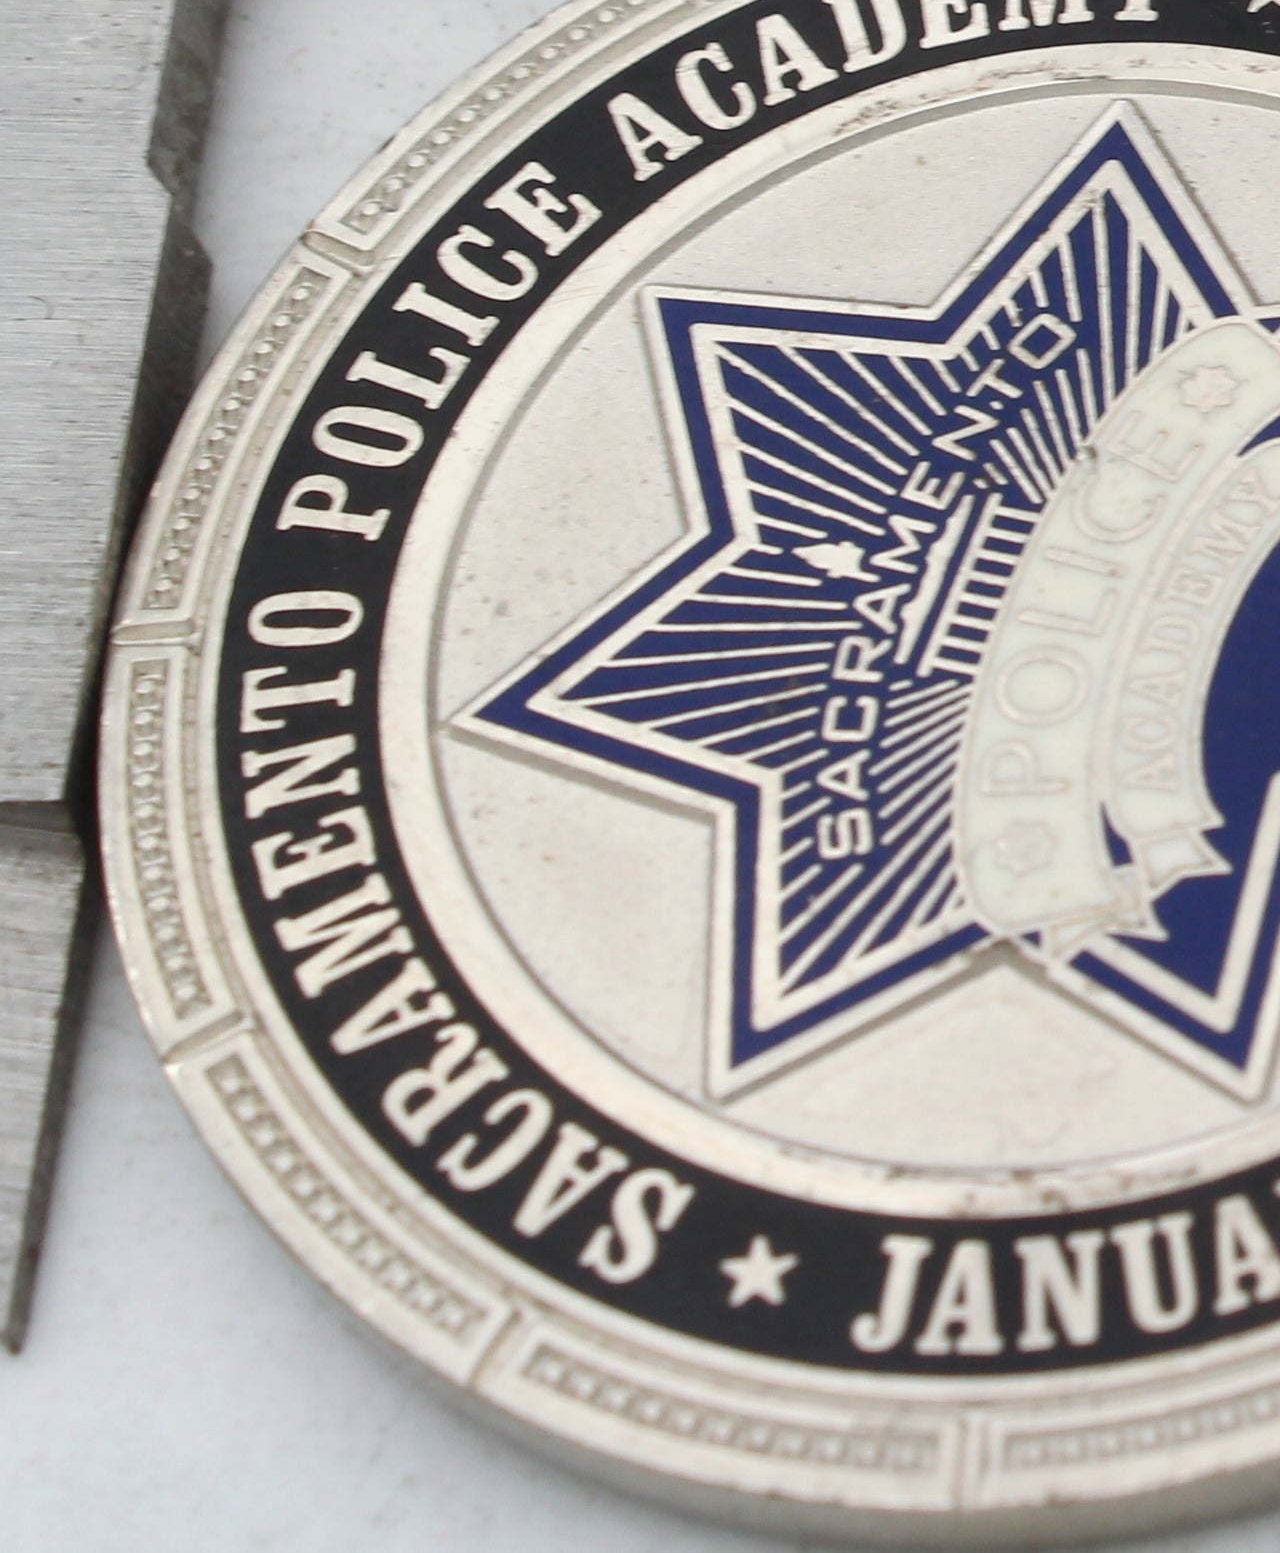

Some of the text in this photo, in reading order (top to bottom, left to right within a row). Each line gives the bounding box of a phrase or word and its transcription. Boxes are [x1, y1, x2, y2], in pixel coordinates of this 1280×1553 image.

[275, 160, 604, 543] POLICE
[816, 310, 1078, 862] SACRAMENTO
[978, 409, 1207, 800] POLICE
[239, 587, 696, 1286] SACRAMENTO
